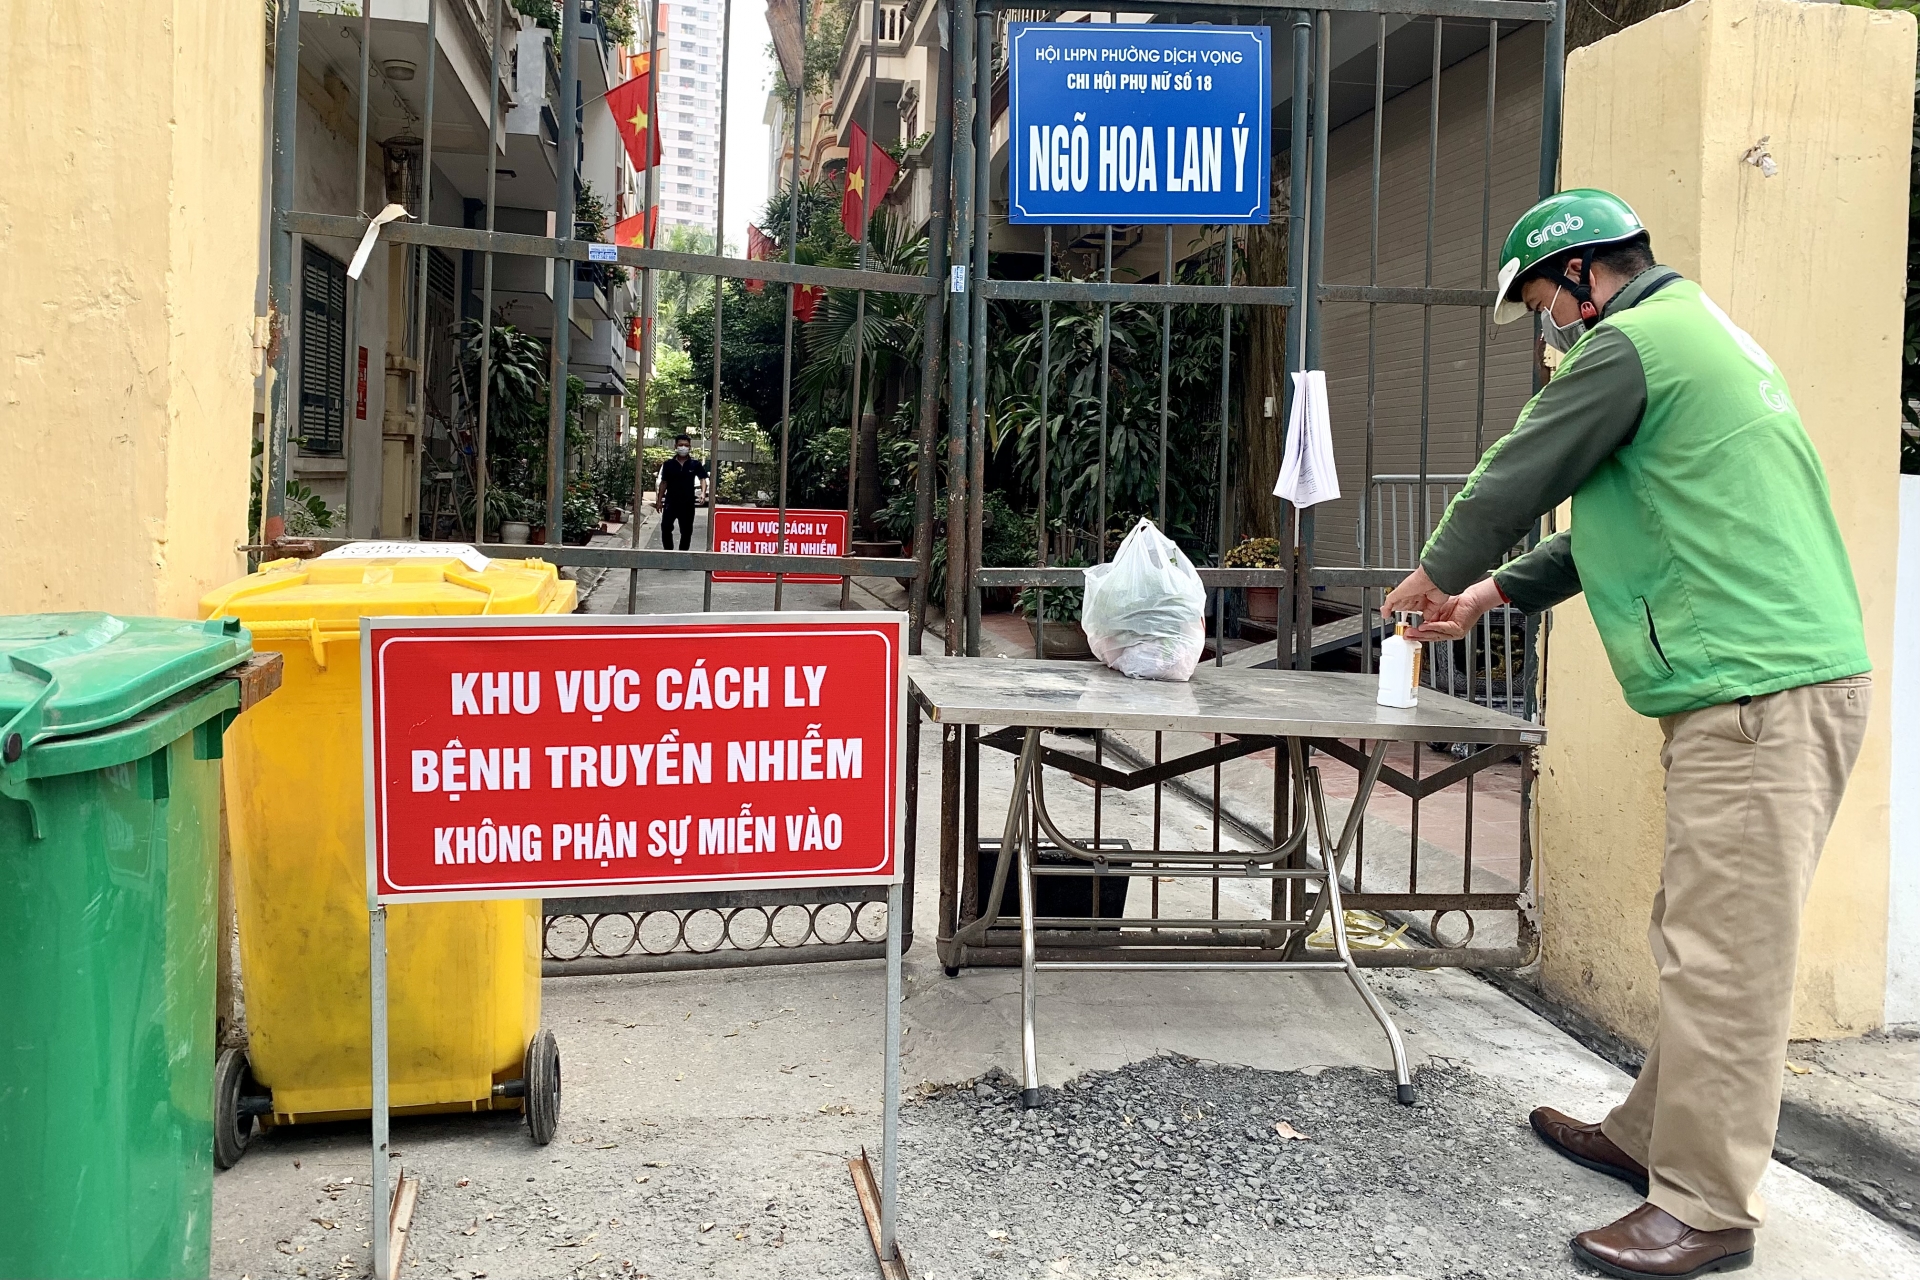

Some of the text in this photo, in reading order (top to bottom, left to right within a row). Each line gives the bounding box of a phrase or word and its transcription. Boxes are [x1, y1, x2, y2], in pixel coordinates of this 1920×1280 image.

[1035, 45, 1243, 66] HỘI LHPN PHƯỜNG DỊCH VỌNG
[1067, 69, 1212, 93] CHI HỘI PHỤ NỮ SỐ 18
[1029, 112, 1250, 193] NGÕ HOA LAN Ý
[1526, 213, 1584, 248] Grab
[731, 520, 828, 537] KHU VỰC CÁCH LY
[801, 539, 837, 555] NHIỄM
[451, 658, 827, 722] KHU VỰC CÁCH LY
[411, 723, 863, 802] BỆNH TRUYỀN NHIỄM
[434, 803, 842, 867] KHÔNG PHẬN SỰ MIỄN VÀO
